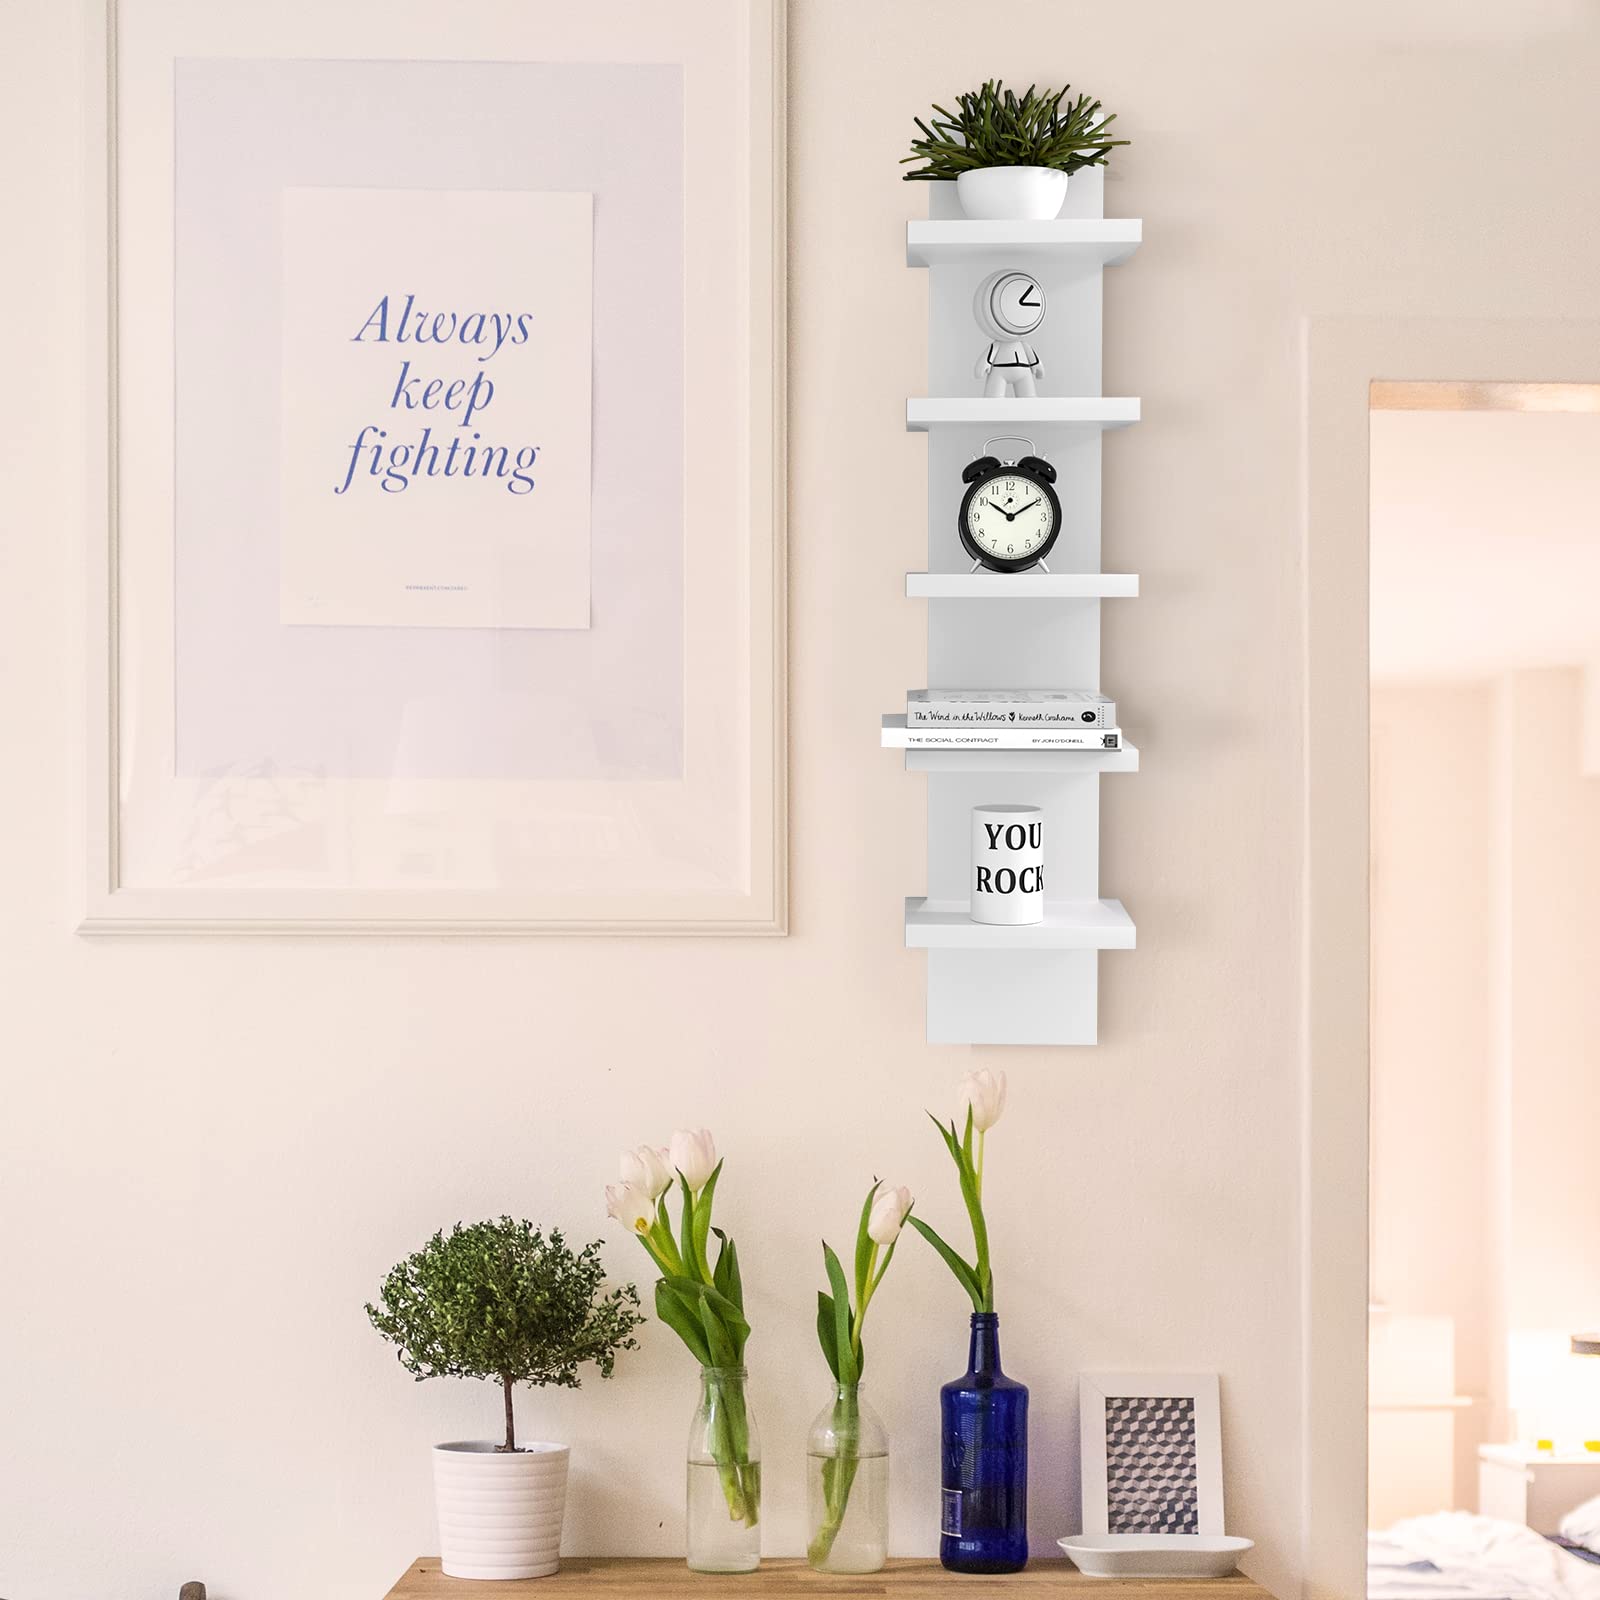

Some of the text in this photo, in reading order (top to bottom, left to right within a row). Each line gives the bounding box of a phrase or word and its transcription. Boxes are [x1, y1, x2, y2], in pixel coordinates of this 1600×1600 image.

[350, 294, 533, 361] Always
[391, 361, 494, 427] keep
[334, 426, 540, 494] fighting
[1005, 481, 1015, 491] 12
[979, 497, 989, 506] 10
[1035, 497, 1042, 506] 2
[973, 512, 980, 522] 9
[1040, 512, 1047, 522] 3
[978, 528, 985, 538] 8
[1035, 529, 1041, 538] 4
[991, 539, 997, 549] 7
[1007, 544, 1014, 554] 6
[1025, 539, 1031, 549] 5
[914, 711, 927, 721] The
[928, 710, 950, 721] Wind
[962, 711, 974, 721] the
[974, 711, 1006, 722] Willows
[984, 822, 1042, 850] YOU
[976, 865, 1044, 894] ROCK
